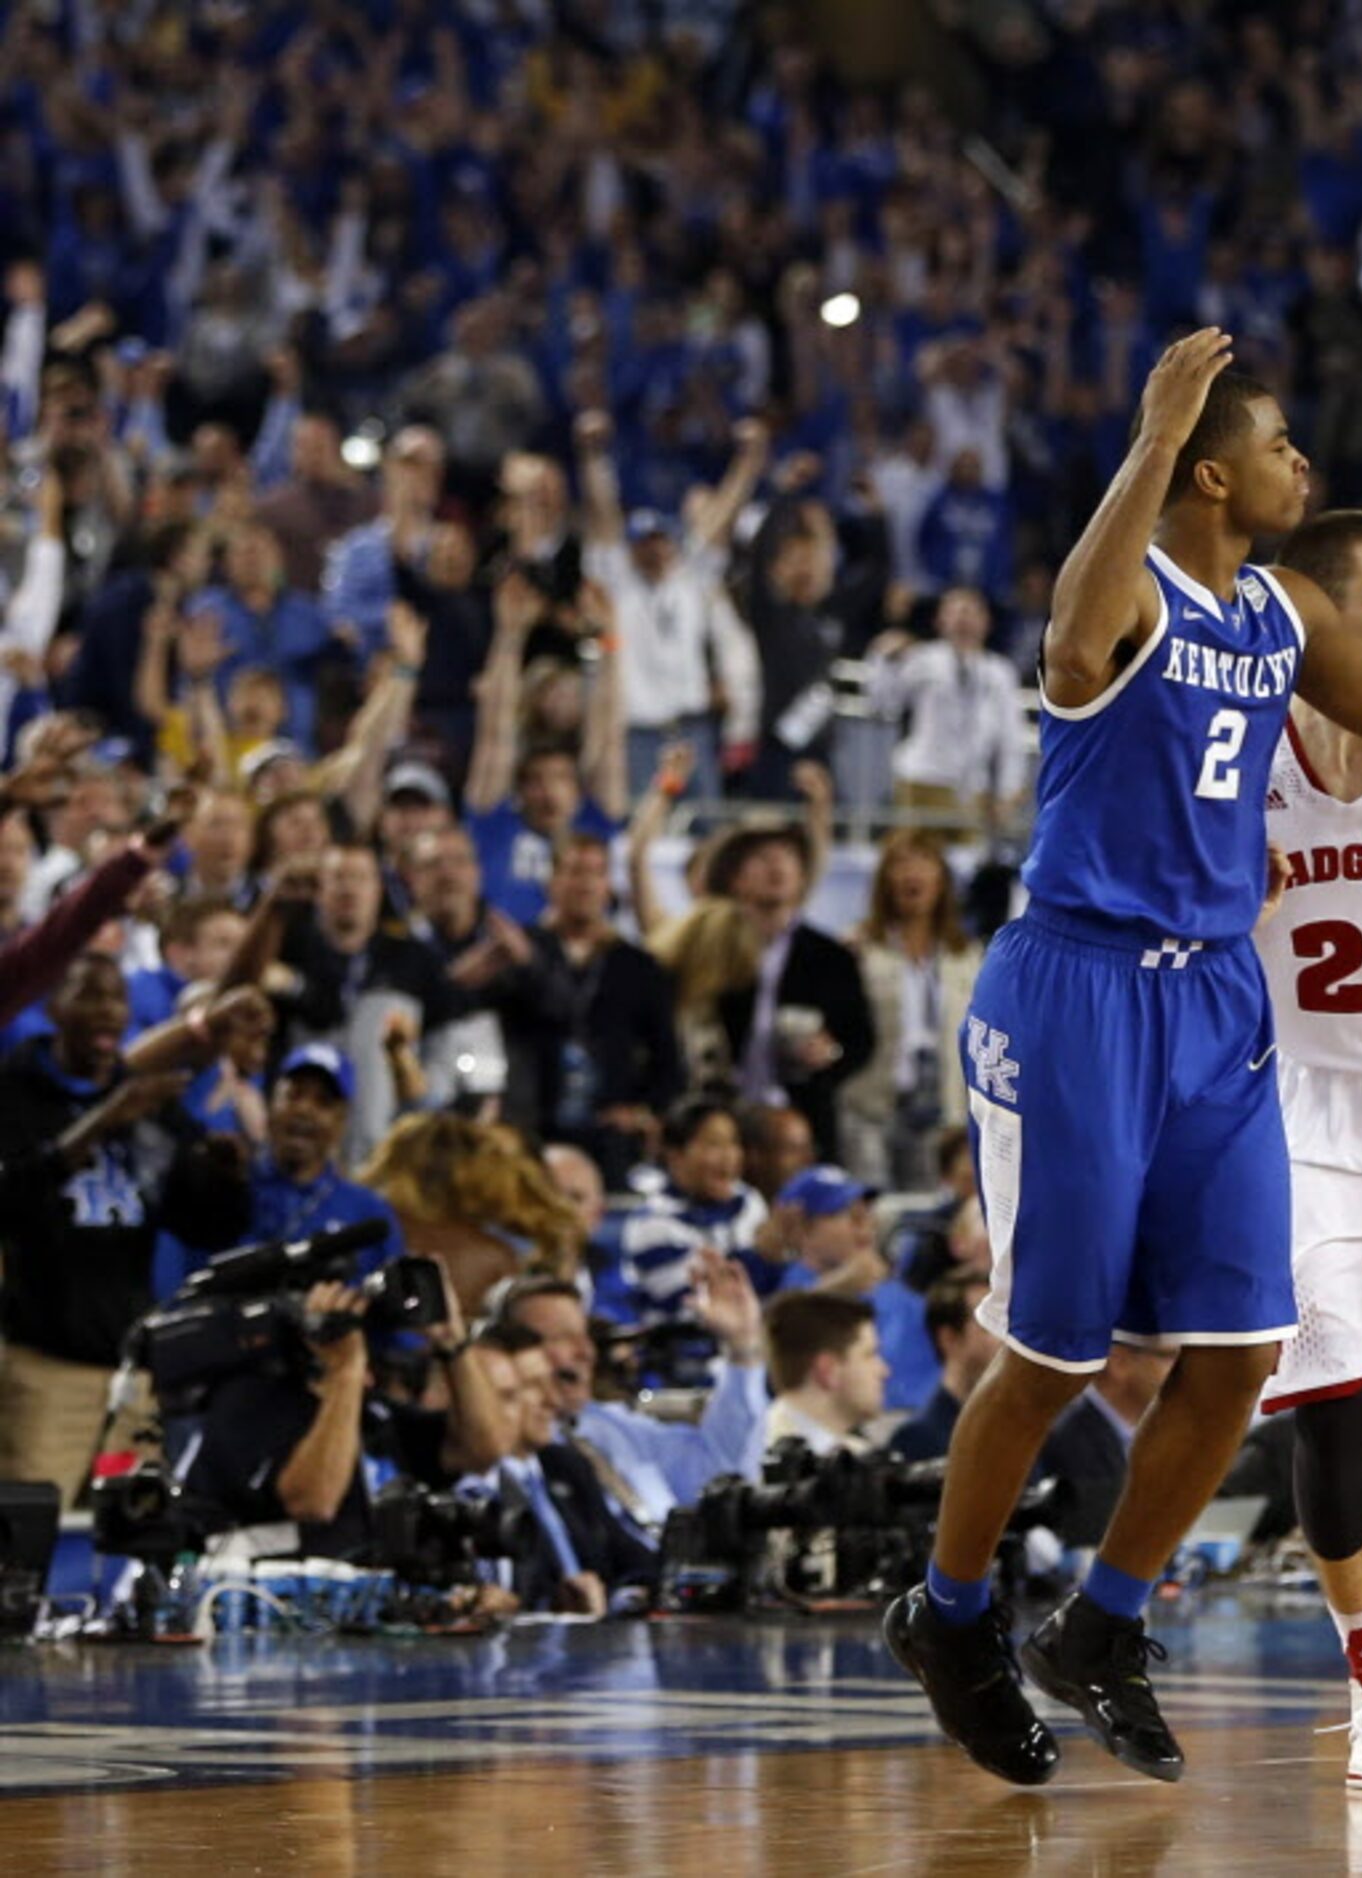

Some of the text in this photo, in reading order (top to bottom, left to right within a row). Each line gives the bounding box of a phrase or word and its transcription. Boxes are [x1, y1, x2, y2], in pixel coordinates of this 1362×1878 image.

[1162, 637, 1297, 699] KENTUCKY
[1194, 708, 1249, 800] 2
[967, 1014, 1020, 1104] UK
